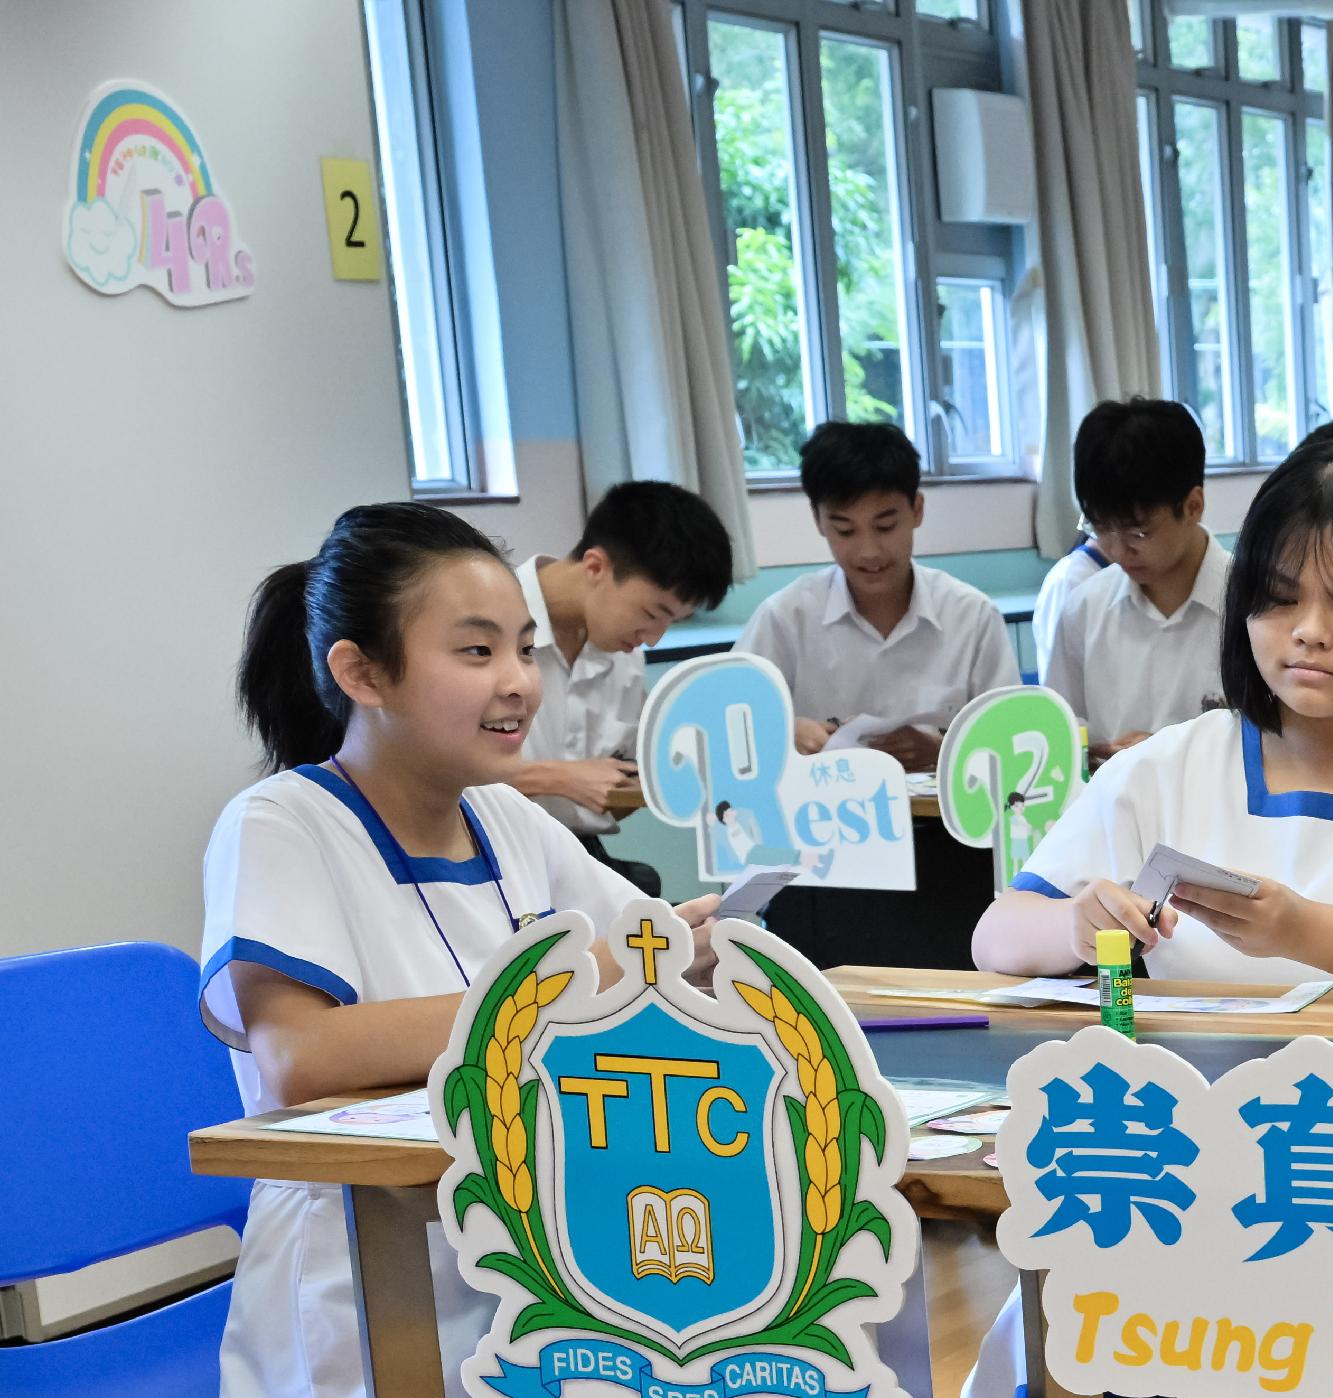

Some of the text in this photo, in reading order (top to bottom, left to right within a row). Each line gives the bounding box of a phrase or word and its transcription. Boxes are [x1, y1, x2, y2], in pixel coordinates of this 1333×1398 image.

[340, 189, 366, 249] 2
[808, 758, 858, 786] 休息
[1072, 1290, 1315, 1393] Tsung
[552, 1347, 634, 1381] FIDES
[724, 1360, 822, 1397] CARITAS
